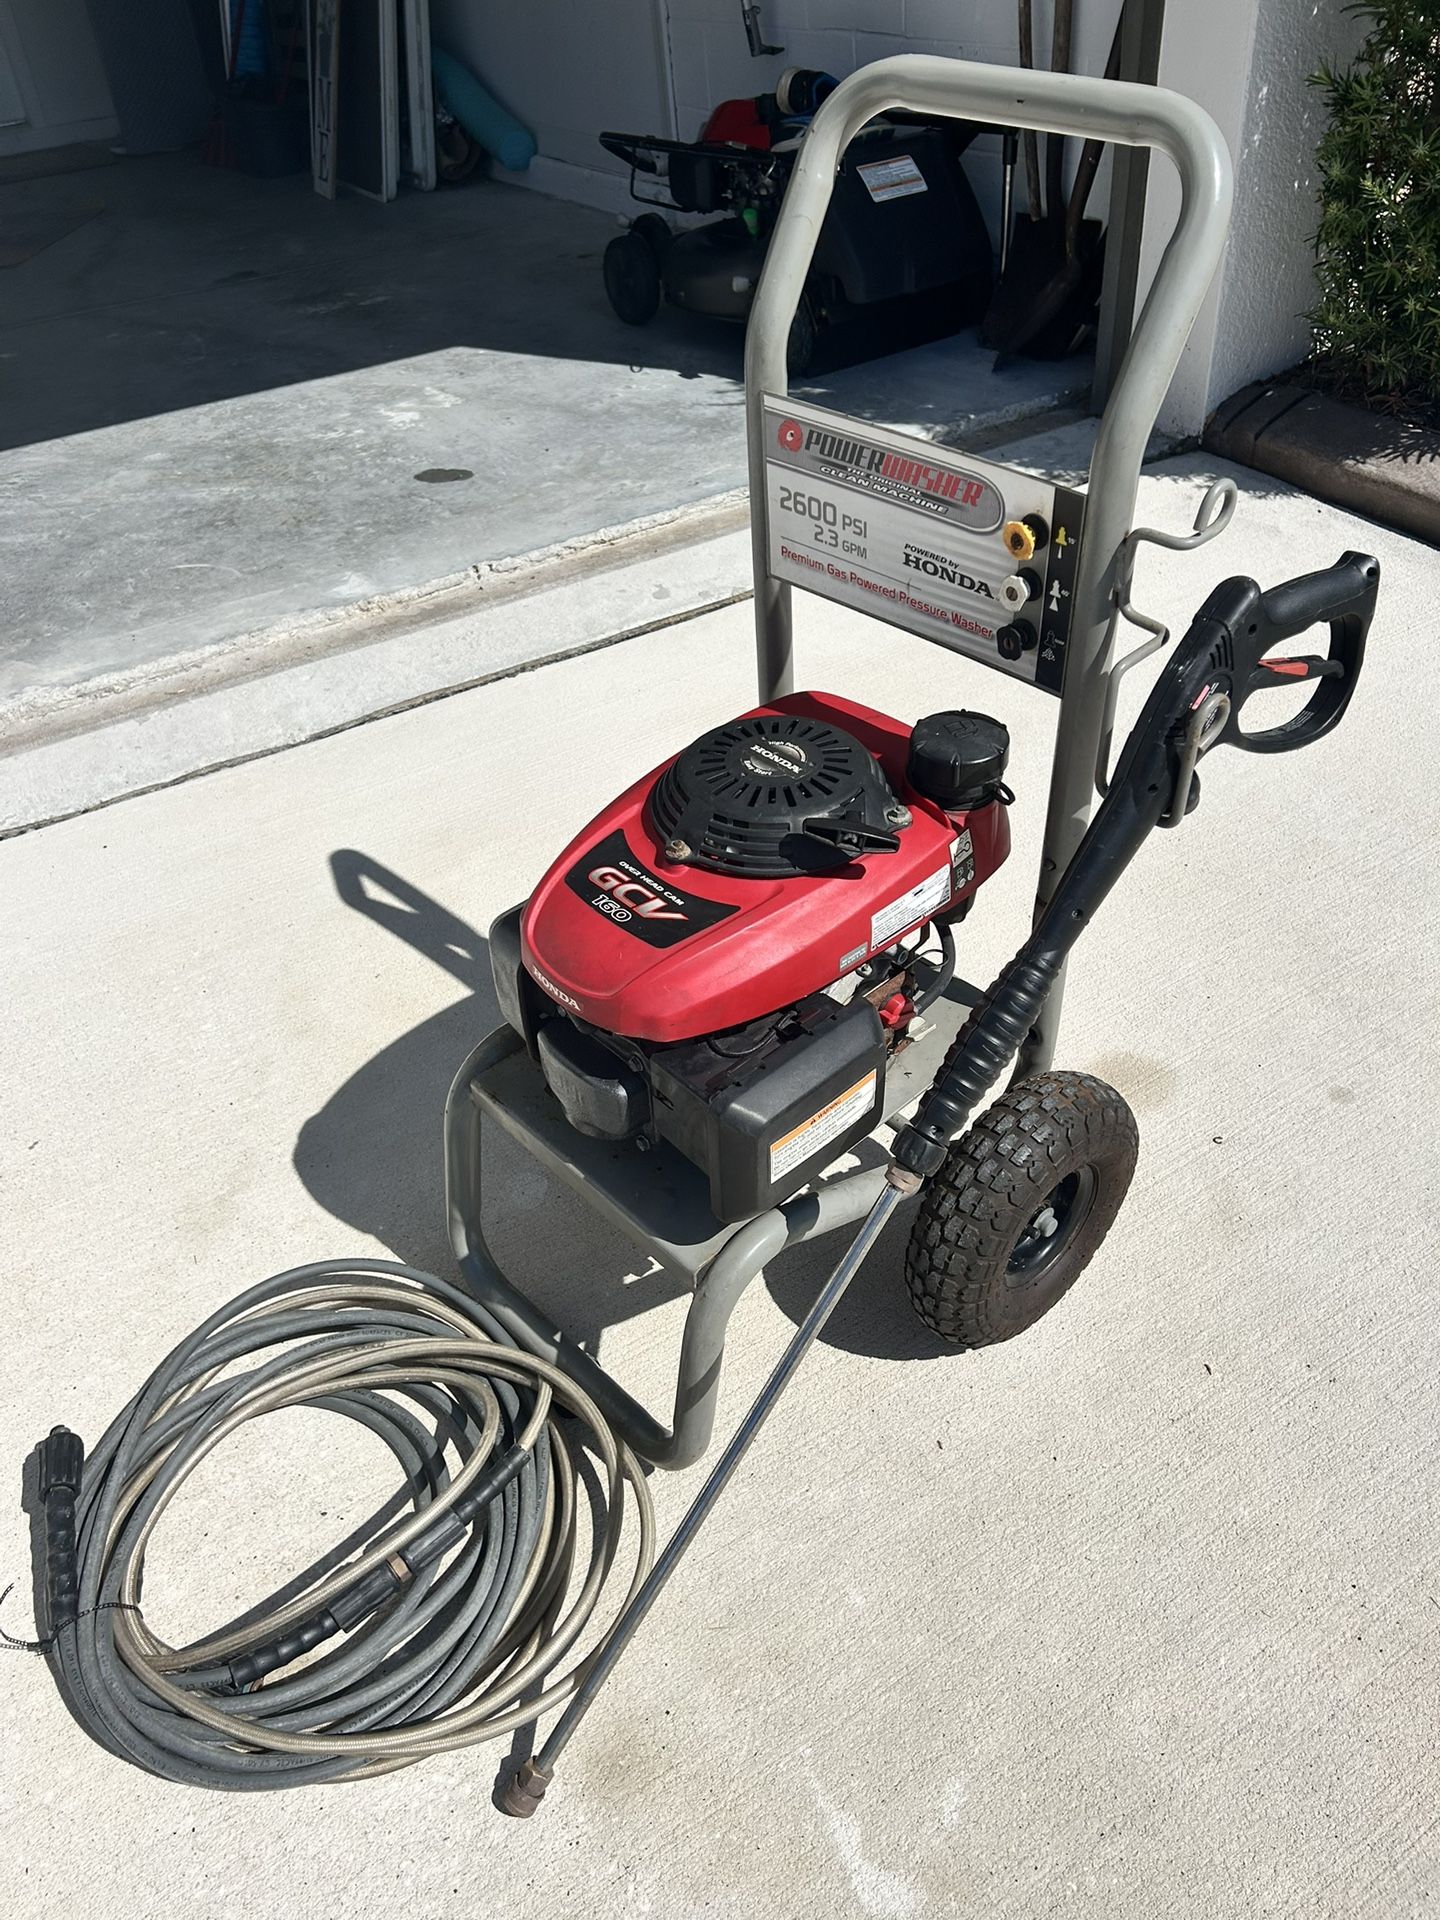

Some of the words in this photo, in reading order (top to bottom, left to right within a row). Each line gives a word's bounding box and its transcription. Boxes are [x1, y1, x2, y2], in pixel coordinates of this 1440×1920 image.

[805, 429, 985, 507] POWERWASHER
[819, 465, 870, 488] CLEAN
[873, 483, 949, 515] MACHINE
[847, 467, 866, 478] THE
[868, 473, 922, 496] ORIGINAL
[779, 486, 837, 527] 2600
[842, 513, 868, 539] PSI
[814, 524, 839, 548] 2.3
[842, 541, 868, 560] GPM
[904, 543, 947, 565] POWERED
[948, 559, 960, 570] by
[781, 545, 825, 572] Premium
[827, 563, 848, 581] Gas
[850, 572, 896, 600] Powered
[899, 591, 948, 620] Pressure
[951, 612, 994, 639] Washer
[902, 552, 995, 600] HONDA
[750, 744, 802, 774] HONDA
[588, 866, 689, 920] GCV
[619, 861, 642, 877] OVER
[639, 875, 665, 892] HEAD
[663, 891, 685, 906] CAM
[591, 894, 633, 922] 160
[532, 964, 581, 1011] HONDA
